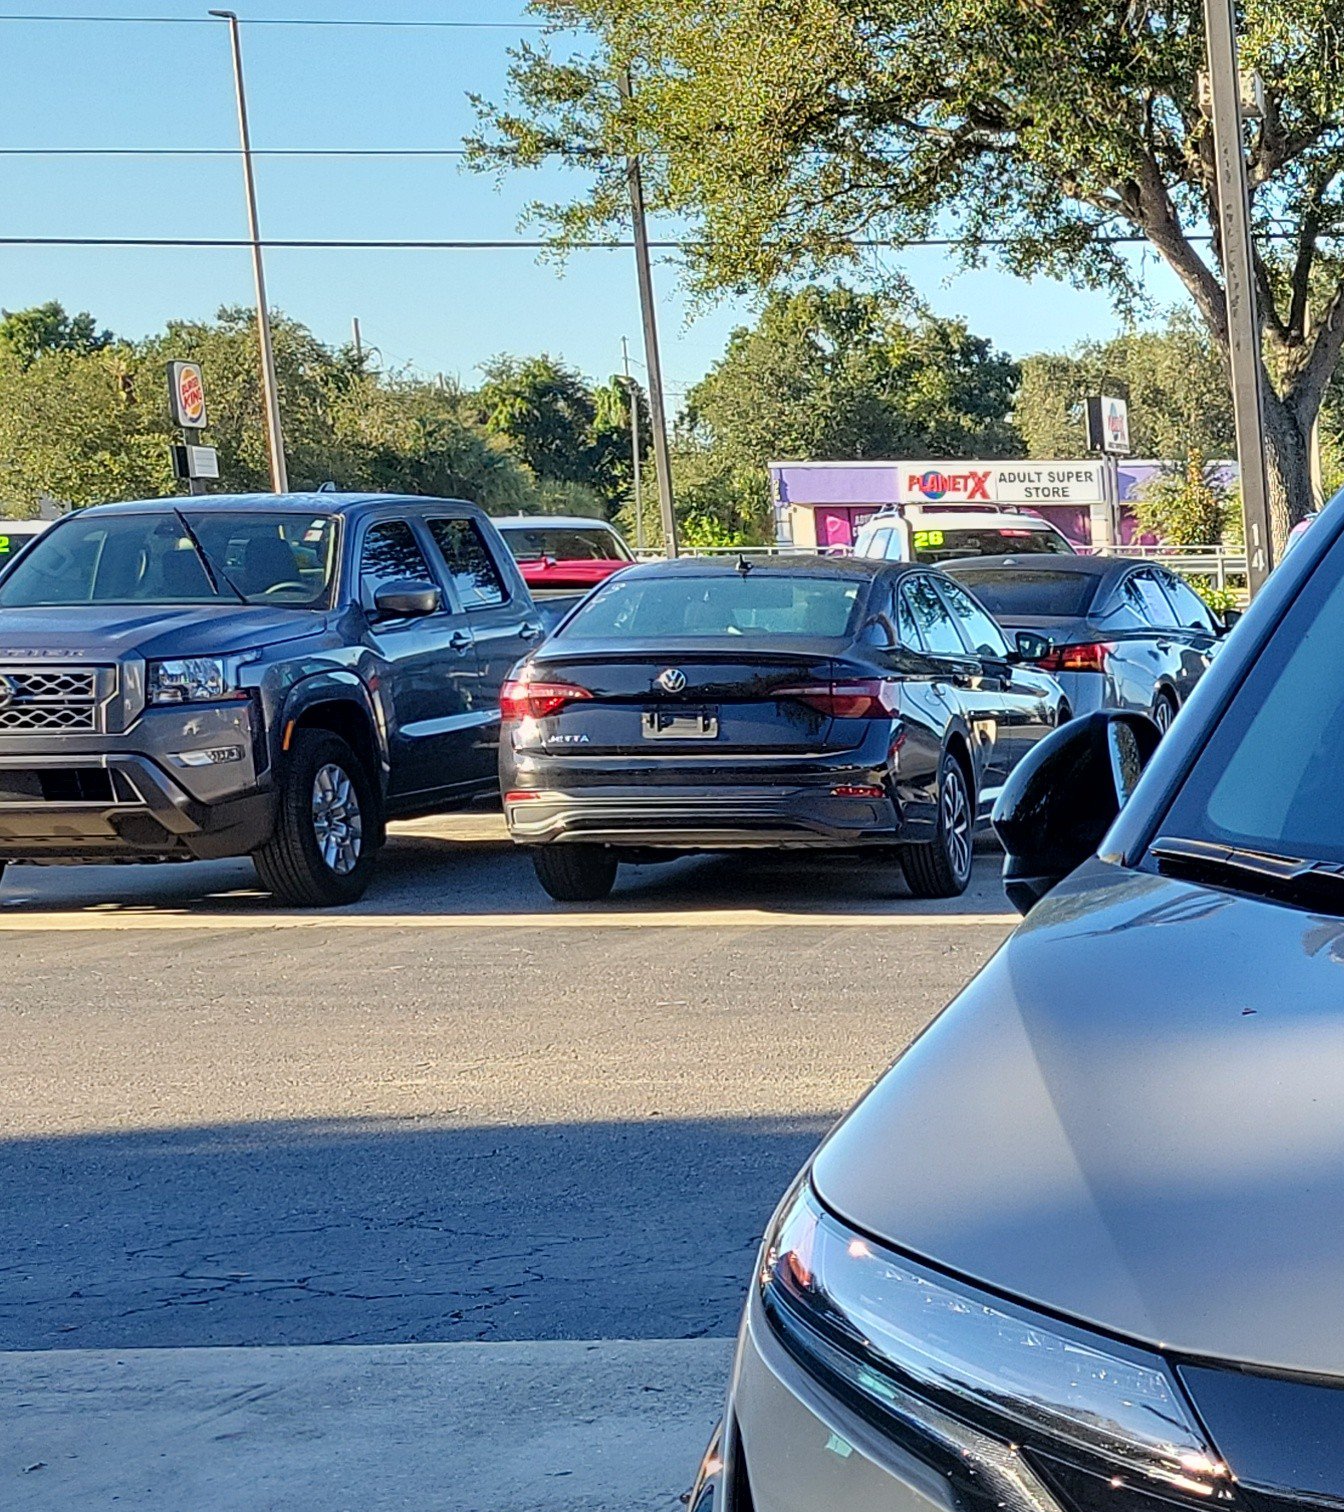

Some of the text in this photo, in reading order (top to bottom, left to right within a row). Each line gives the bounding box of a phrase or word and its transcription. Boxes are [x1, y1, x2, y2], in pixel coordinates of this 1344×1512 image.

[999, 471, 1094, 483] ADULT SUPER
[1024, 486, 1070, 498] STORE
